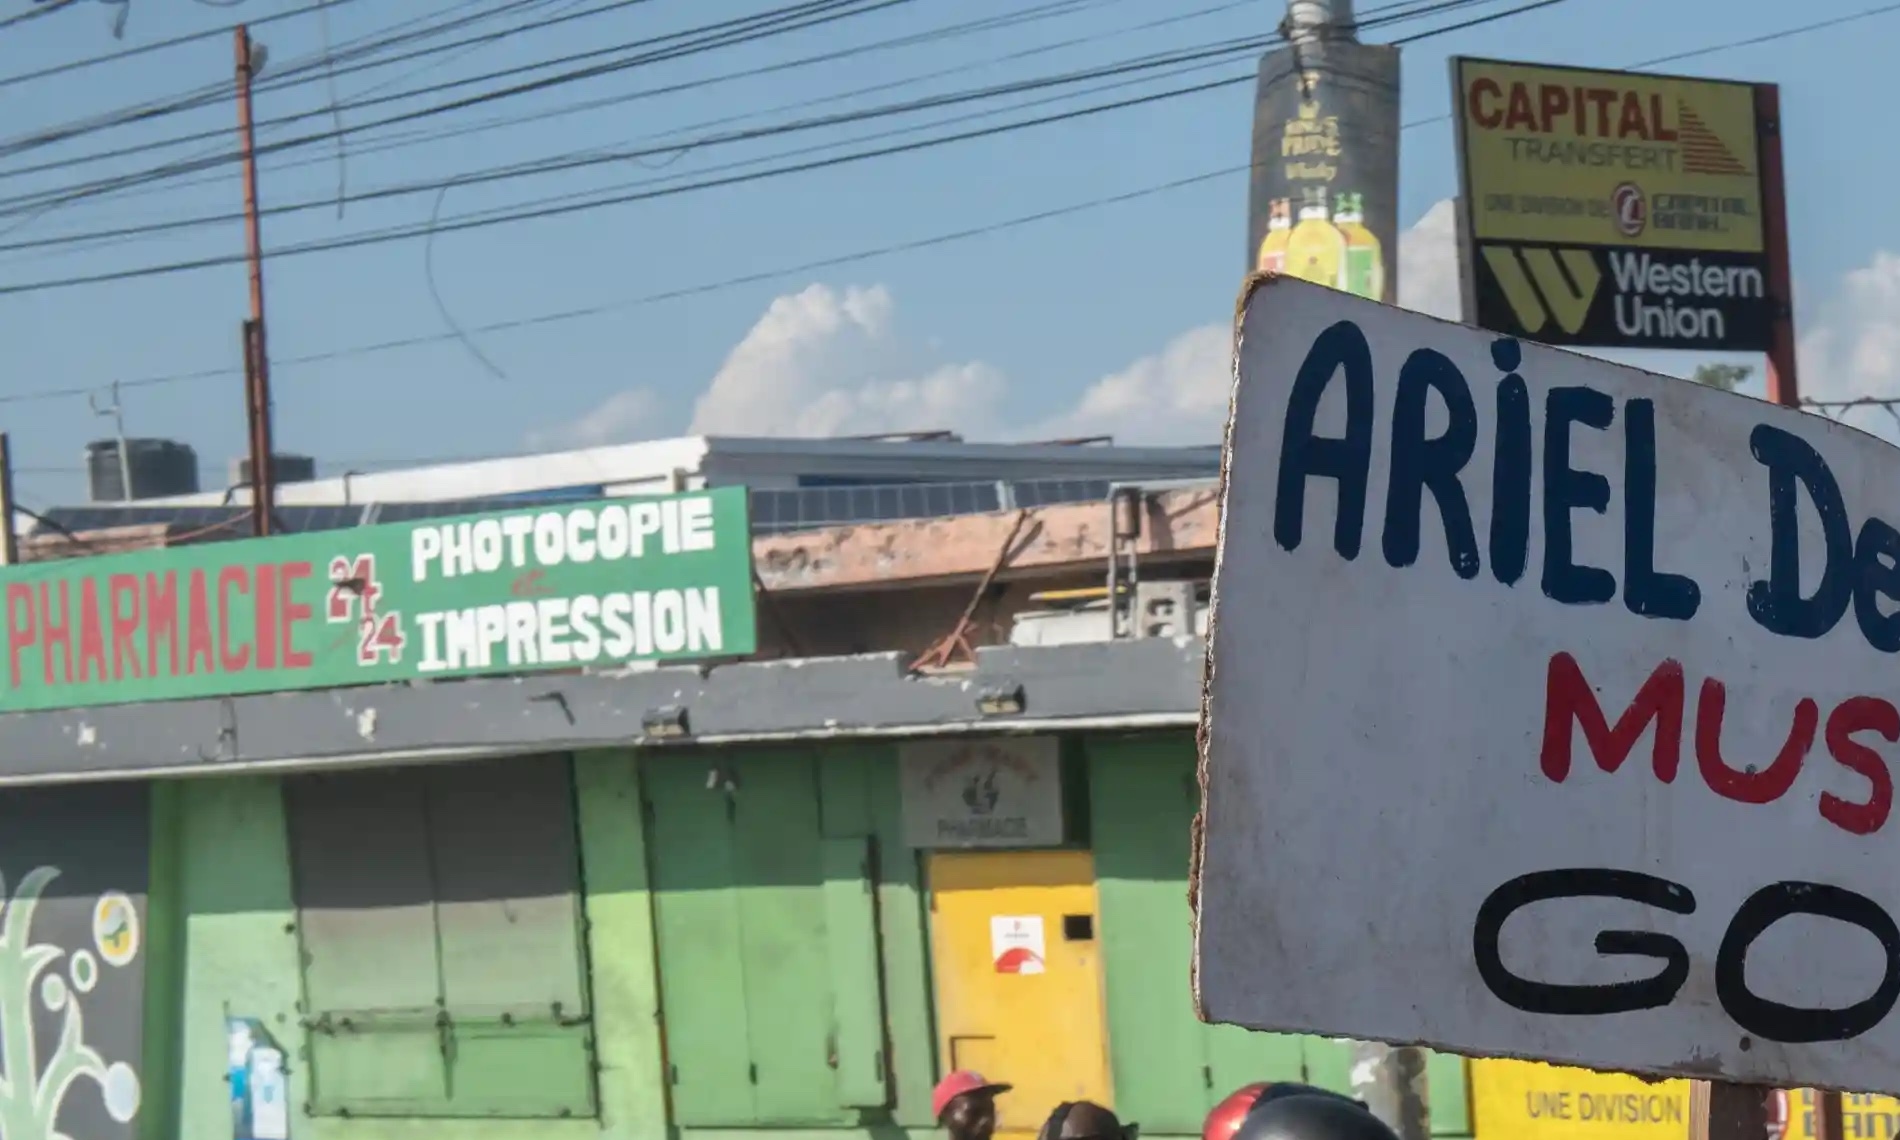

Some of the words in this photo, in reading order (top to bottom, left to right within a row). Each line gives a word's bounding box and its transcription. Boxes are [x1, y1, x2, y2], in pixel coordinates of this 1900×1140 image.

[1469, 77, 1679, 141] CAPITAL
[1503, 136, 1679, 171] TRANSFERT
[1609, 250, 1764, 298] Western
[1614, 295, 1725, 339] Union
[411, 497, 715, 582] PHOTOCOPIE
[6, 560, 313, 690] PHARMACIE
[415, 586, 723, 672] IMPRESSION
[1526, 1090, 1573, 1121] UNE
[1579, 1091, 1682, 1125] DIVISION
